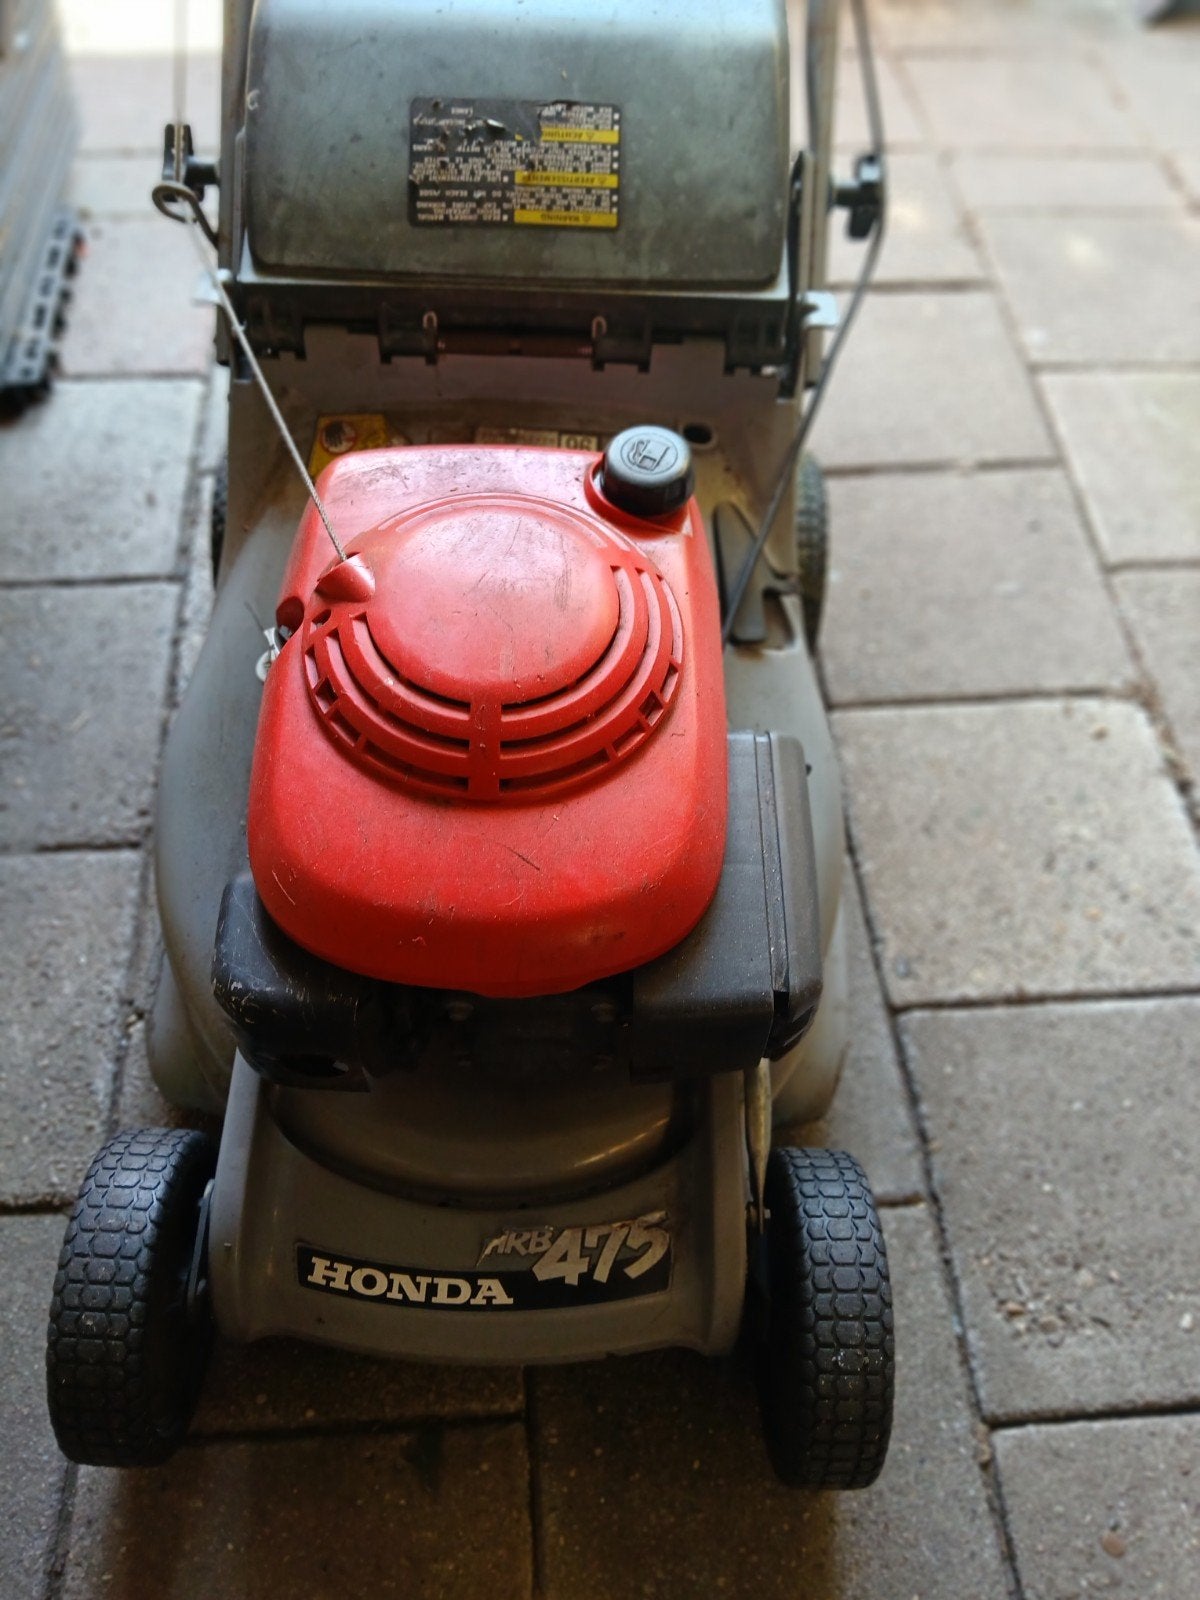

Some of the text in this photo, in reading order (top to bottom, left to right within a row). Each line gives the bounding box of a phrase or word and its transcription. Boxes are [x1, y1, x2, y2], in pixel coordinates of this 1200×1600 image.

[484, 1211, 670, 1286] HRB 475
[306, 1256, 514, 1305] HONDA
